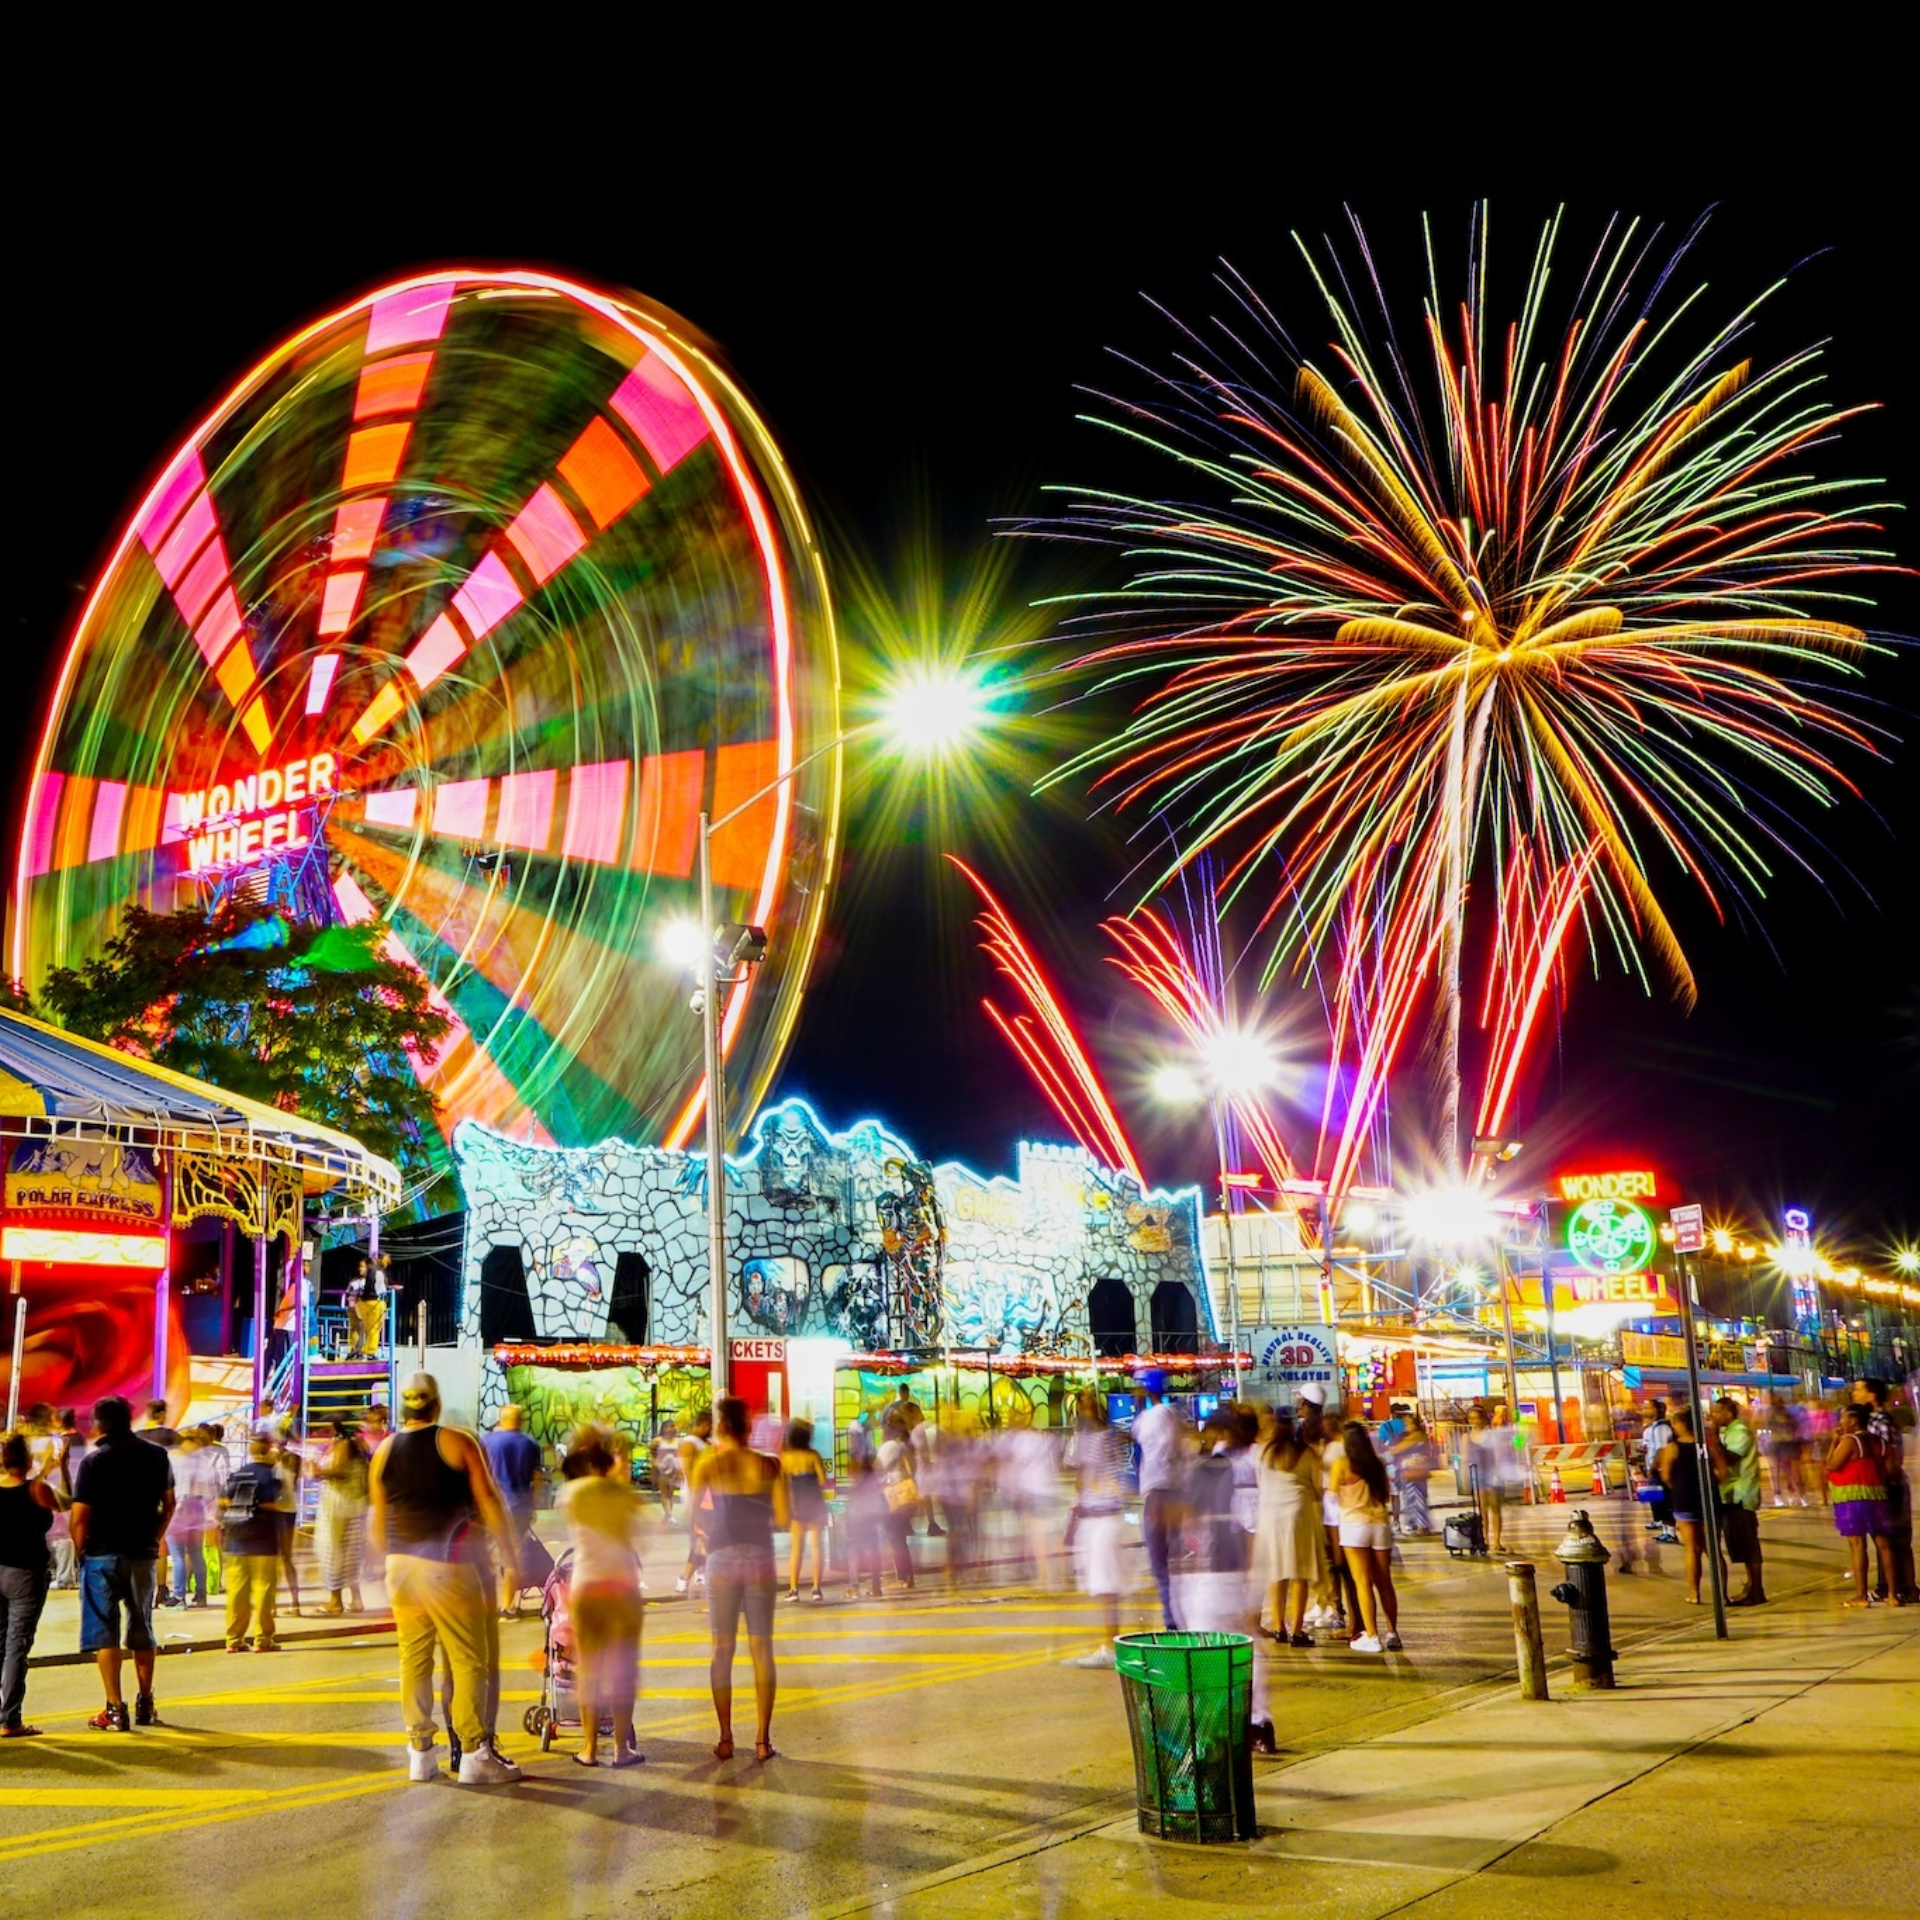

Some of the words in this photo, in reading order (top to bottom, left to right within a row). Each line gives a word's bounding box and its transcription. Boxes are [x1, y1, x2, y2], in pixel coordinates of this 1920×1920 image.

[180, 753, 334, 831] WONDER
[189, 811, 308, 874] WHEEL
[1561, 1172, 1650, 1200] WONDER
[16, 1187, 73, 1206] POLAR
[77, 1189, 156, 1218] EXPRESS
[1574, 1274, 1658, 1300] WHEEL
[730, 1341, 783, 1358] ICKETS
[1262, 1332, 1294, 1367] VIRTUAL
[1297, 1331, 1334, 1364] REALITY
[1280, 1345, 1315, 1367] 3D
[1266, 1371, 1331, 1381] SMULATOR
